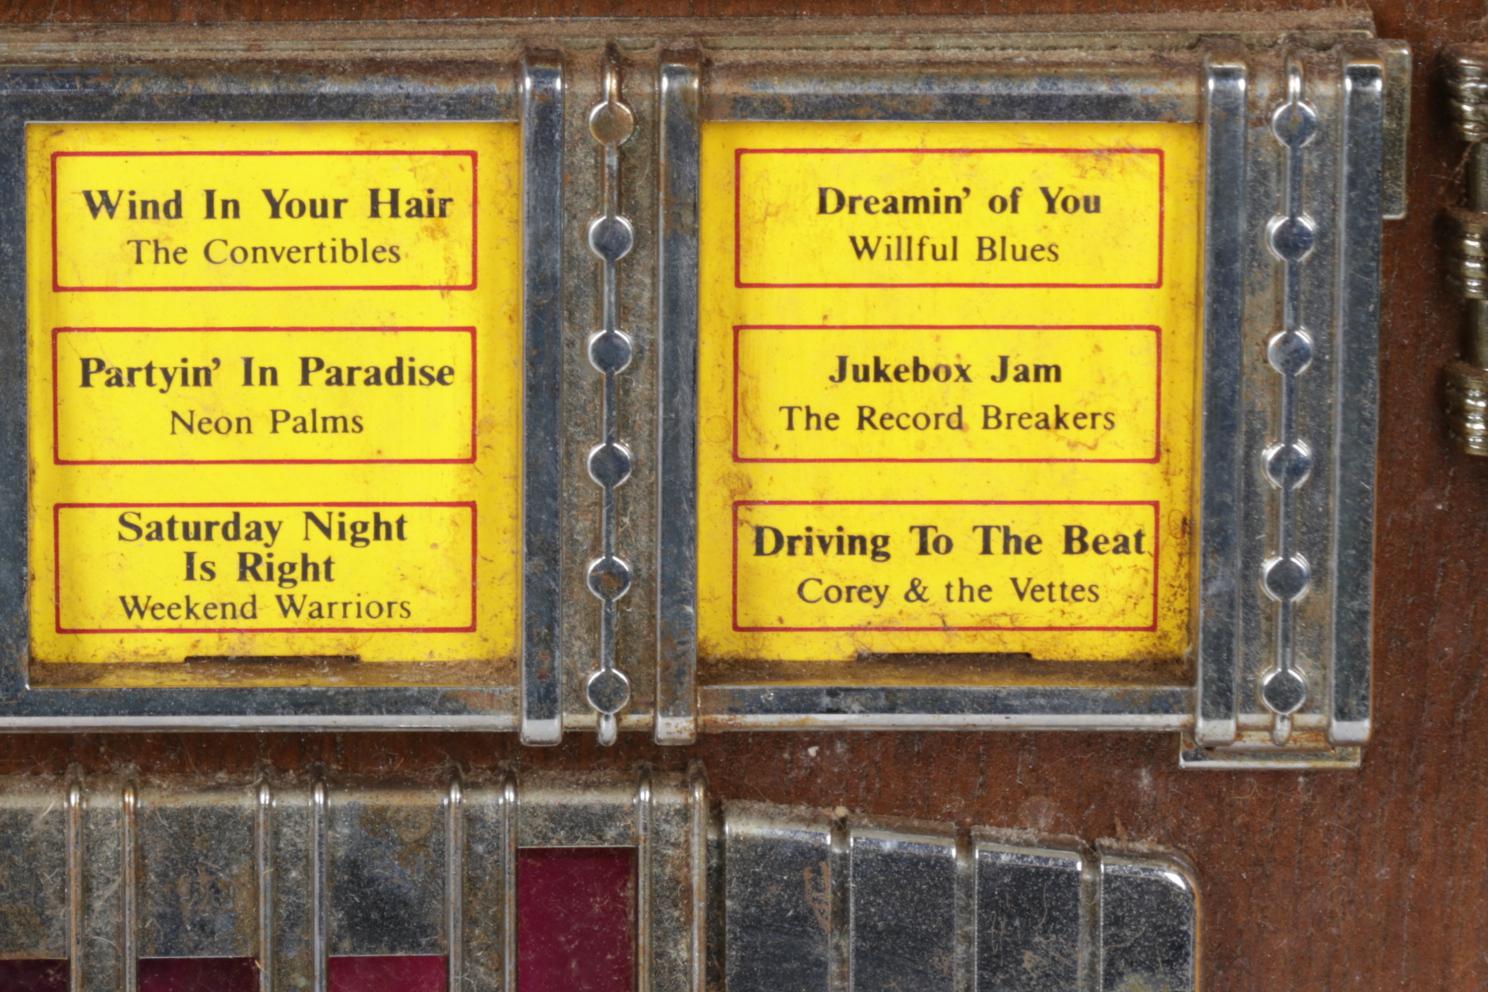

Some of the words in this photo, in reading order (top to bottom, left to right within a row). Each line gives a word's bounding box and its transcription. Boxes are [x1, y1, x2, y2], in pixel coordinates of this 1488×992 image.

[81, 189, 183, 221] Wind
[203, 189, 241, 220] In
[261, 188, 349, 220] Your
[368, 187, 454, 219] Hair
[817, 186, 971, 215] Dreamin'
[987, 186, 1023, 215] of
[1039, 186, 1101, 215] You
[126, 238, 188, 265] The
[203, 237, 401, 265] Convertibles
[848, 235, 958, 262] Willful
[976, 235, 1059, 263] Blues
[79, 356, 221, 394] Partyin'
[242, 356, 279, 387] In
[299, 356, 455, 387] Paradise
[828, 355, 973, 384] Jukebox
[990, 355, 1062, 384] Jam
[170, 409, 253, 436] Neon
[270, 407, 364, 434] Palms
[778, 404, 840, 432] The
[856, 404, 964, 431] Record
[981, 404, 1115, 431] Breakers
[118, 511, 283, 549] Saturday
[303, 510, 408, 548] Night
[750, 524, 892, 563] Driving
[908, 524, 954, 556] To
[972, 524, 1043, 556] The
[1062, 524, 1146, 556] Beat
[183, 551, 217, 582] Is
[237, 551, 335, 589] Right
[118, 593, 258, 621] Weekend
[274, 593, 412, 620] Warriors
[796, 577, 890, 609] Corey
[903, 577, 930, 604] &
[944, 576, 993, 603] the
[1009, 576, 1100, 603] Vettes
